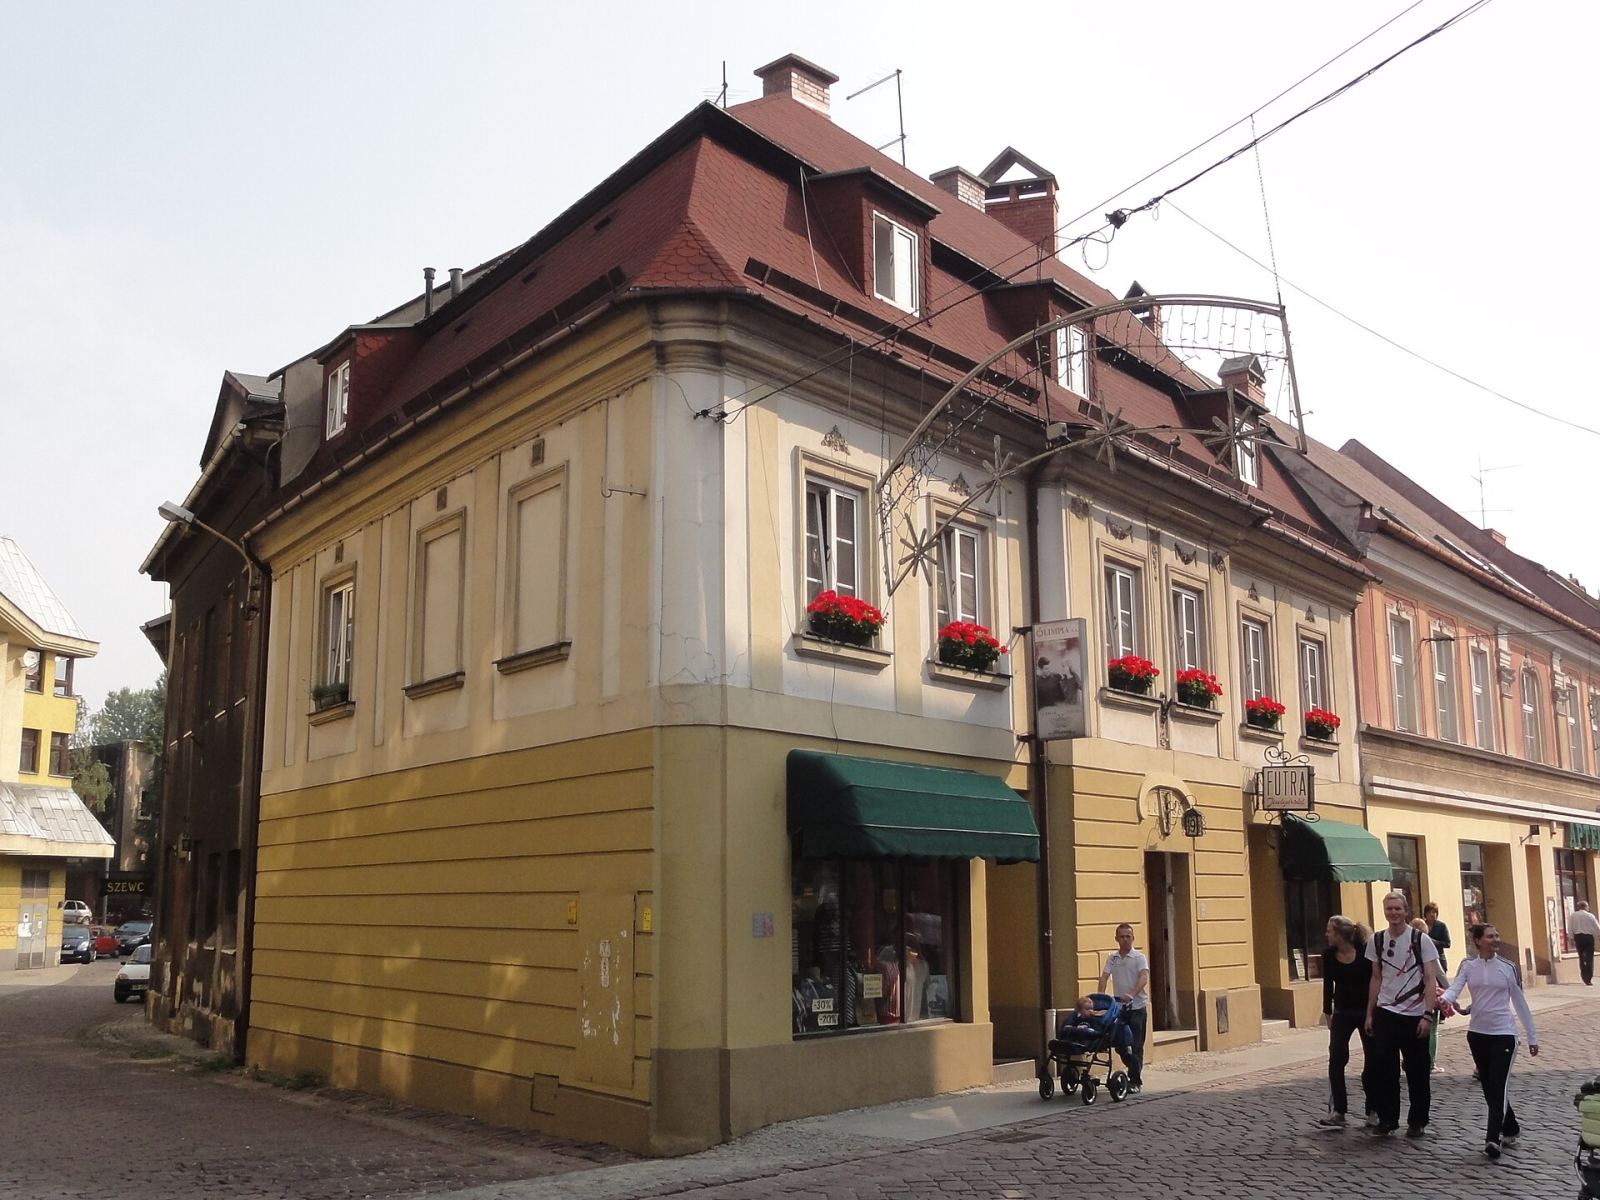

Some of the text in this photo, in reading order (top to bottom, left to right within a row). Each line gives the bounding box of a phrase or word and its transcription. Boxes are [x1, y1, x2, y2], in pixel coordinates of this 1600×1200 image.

[1267, 771, 1306, 796] FUTRA
[1569, 822, 1600, 849] APTE
[107, 882, 144, 893] SZEWC
[814, 1000, 831, 1010] -30%
